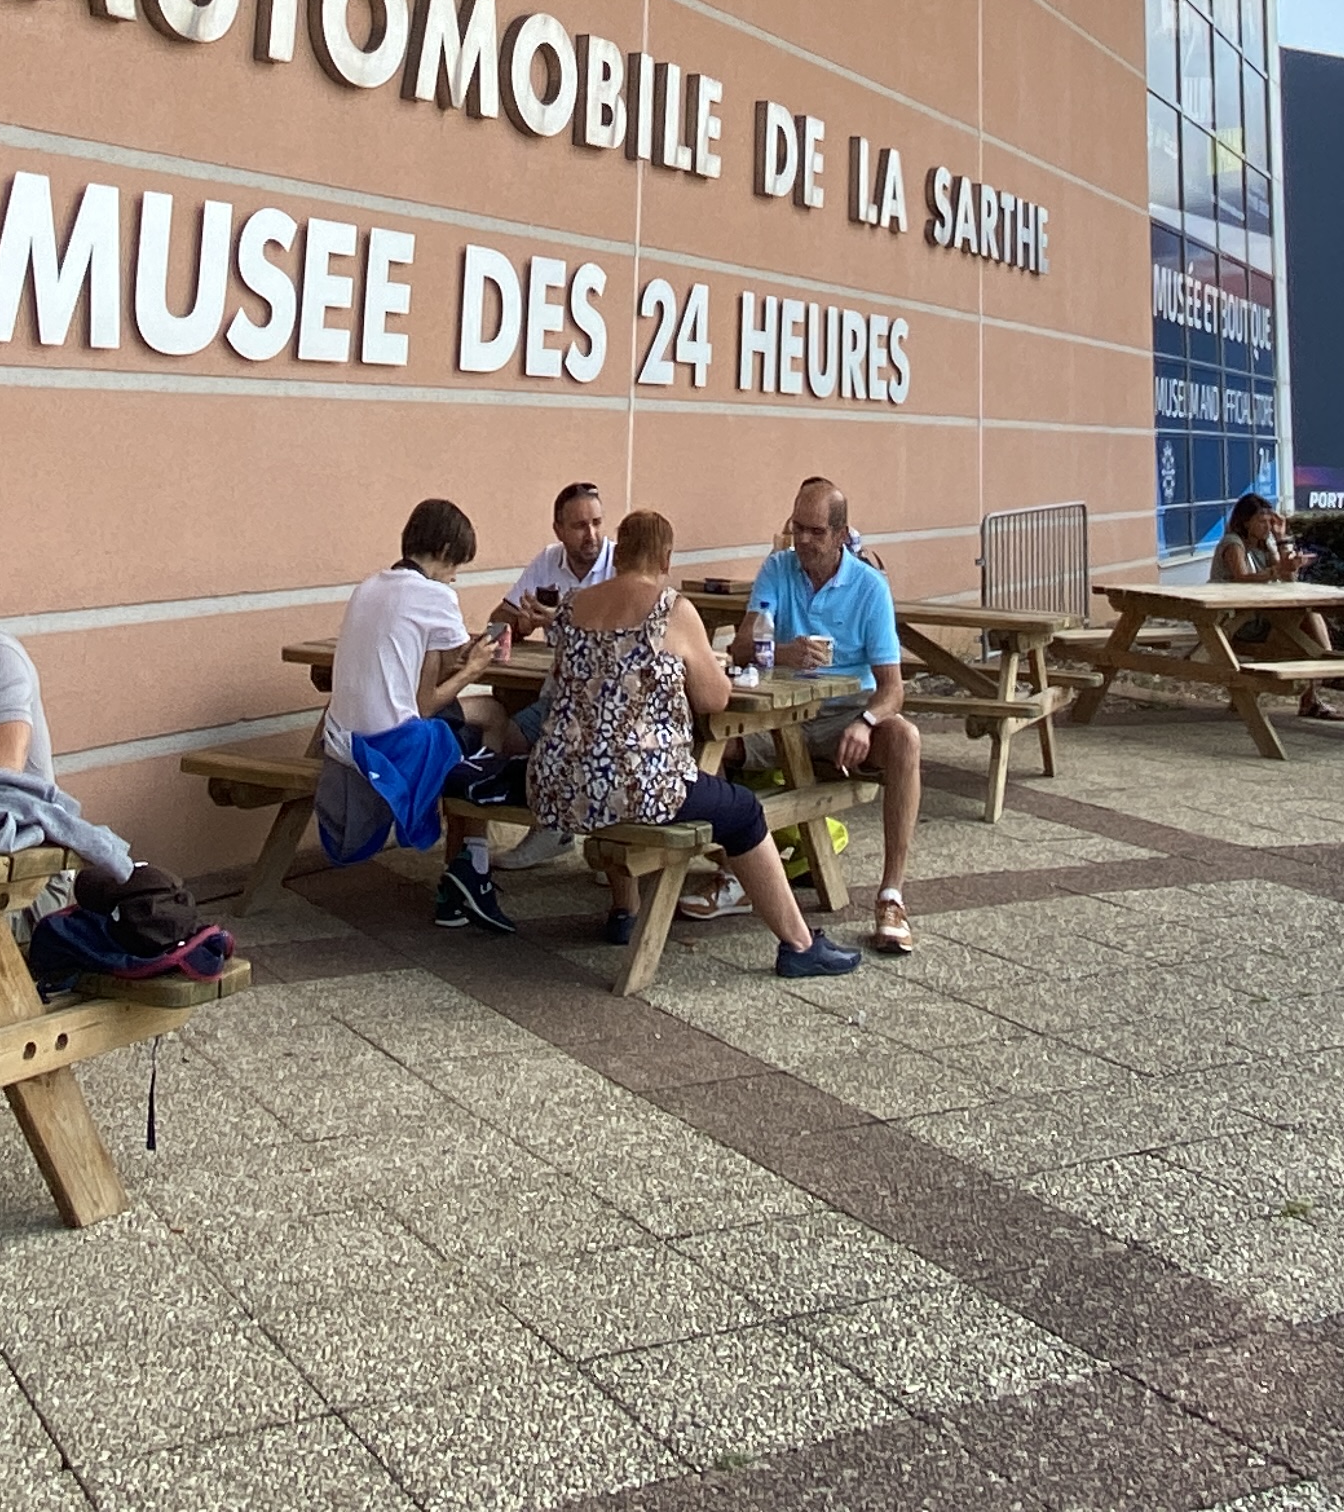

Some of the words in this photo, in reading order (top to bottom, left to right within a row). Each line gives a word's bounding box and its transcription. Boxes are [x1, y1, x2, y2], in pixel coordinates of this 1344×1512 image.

[755, 100, 825, 208] DE
[850, 136, 908, 233] LA
[926, 166, 1049, 275] SARTHE
[459, 244, 608, 383] DES
[639, 278, 711, 387] 24
[737, 291, 911, 404] HEURES
[1153, 261, 1203, 329] MUSÉE
[1204, 283, 1219, 334] ET
[1220, 289, 1272, 361] BOUTQUE
